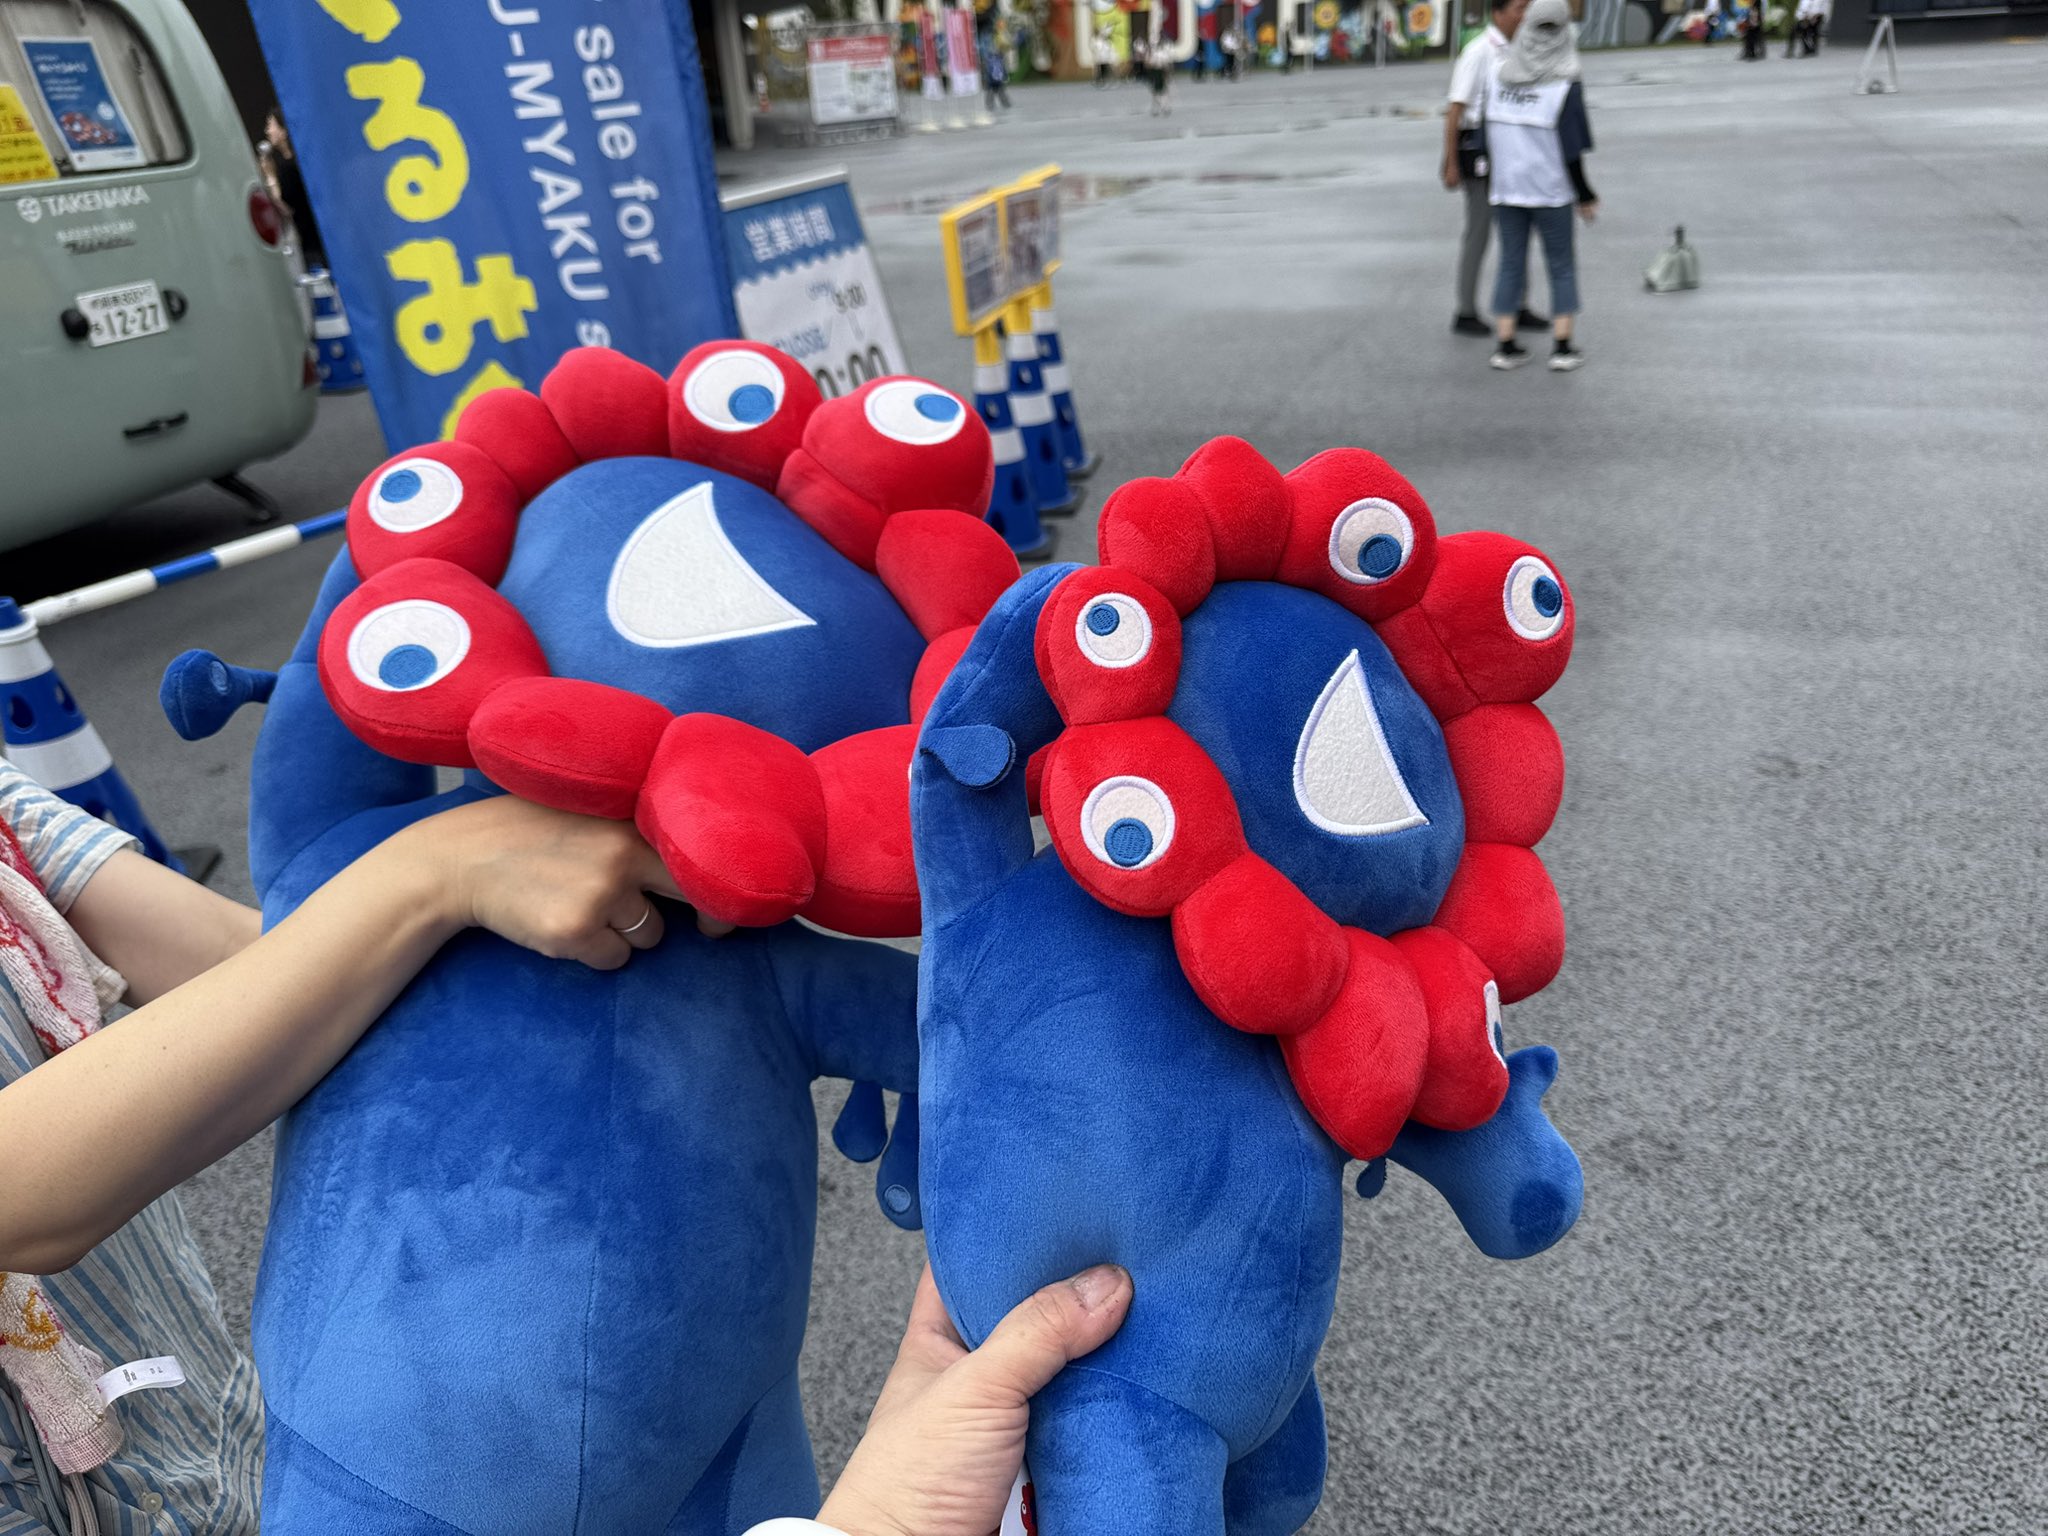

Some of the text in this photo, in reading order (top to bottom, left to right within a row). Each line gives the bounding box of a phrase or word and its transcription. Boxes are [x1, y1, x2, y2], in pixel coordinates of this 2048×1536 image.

[44, 185, 150, 216] TAKENAKA
[573, 24, 663, 264] sale for
